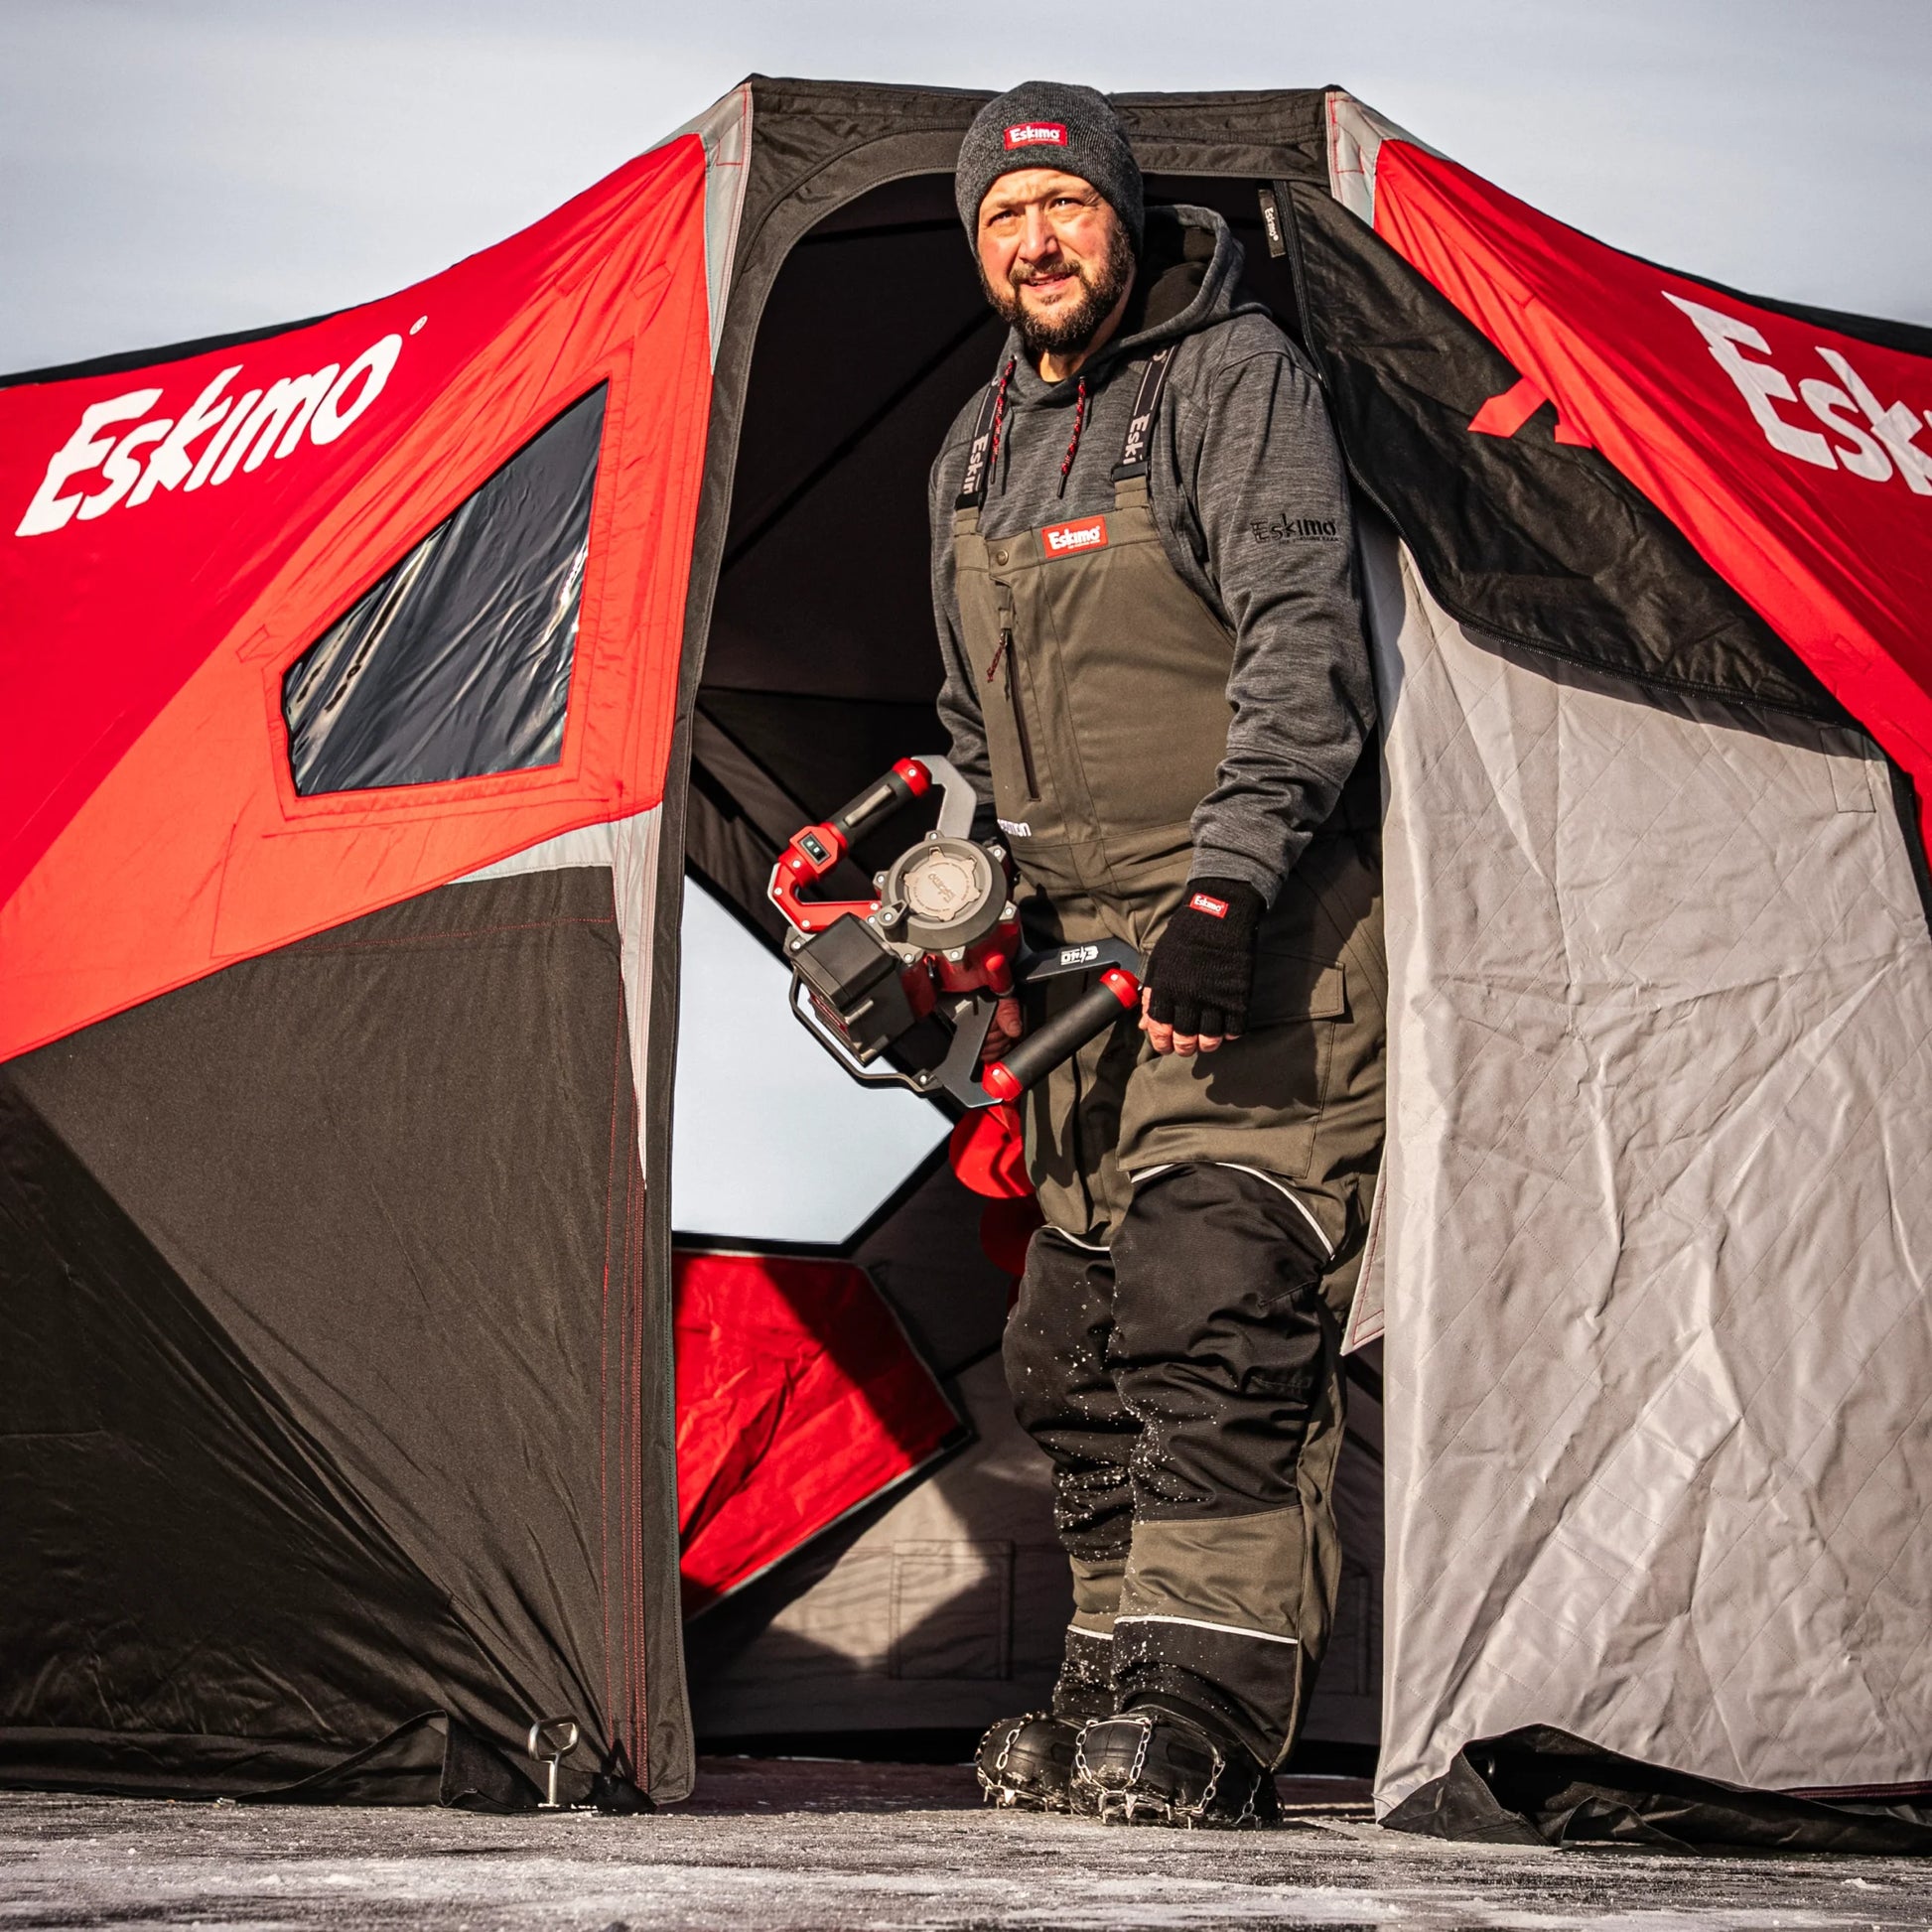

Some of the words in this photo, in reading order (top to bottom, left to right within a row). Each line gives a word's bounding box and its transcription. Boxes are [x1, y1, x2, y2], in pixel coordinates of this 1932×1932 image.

[1010, 125, 1060, 143] Eskimo
[1661, 290, 1932, 496] Esk
[15, 334, 403, 537] Eskimo
[1123, 412, 1151, 465] Eski
[1047, 527, 1101, 550] Eskimo
[1250, 513, 1336, 544] Eskimo
